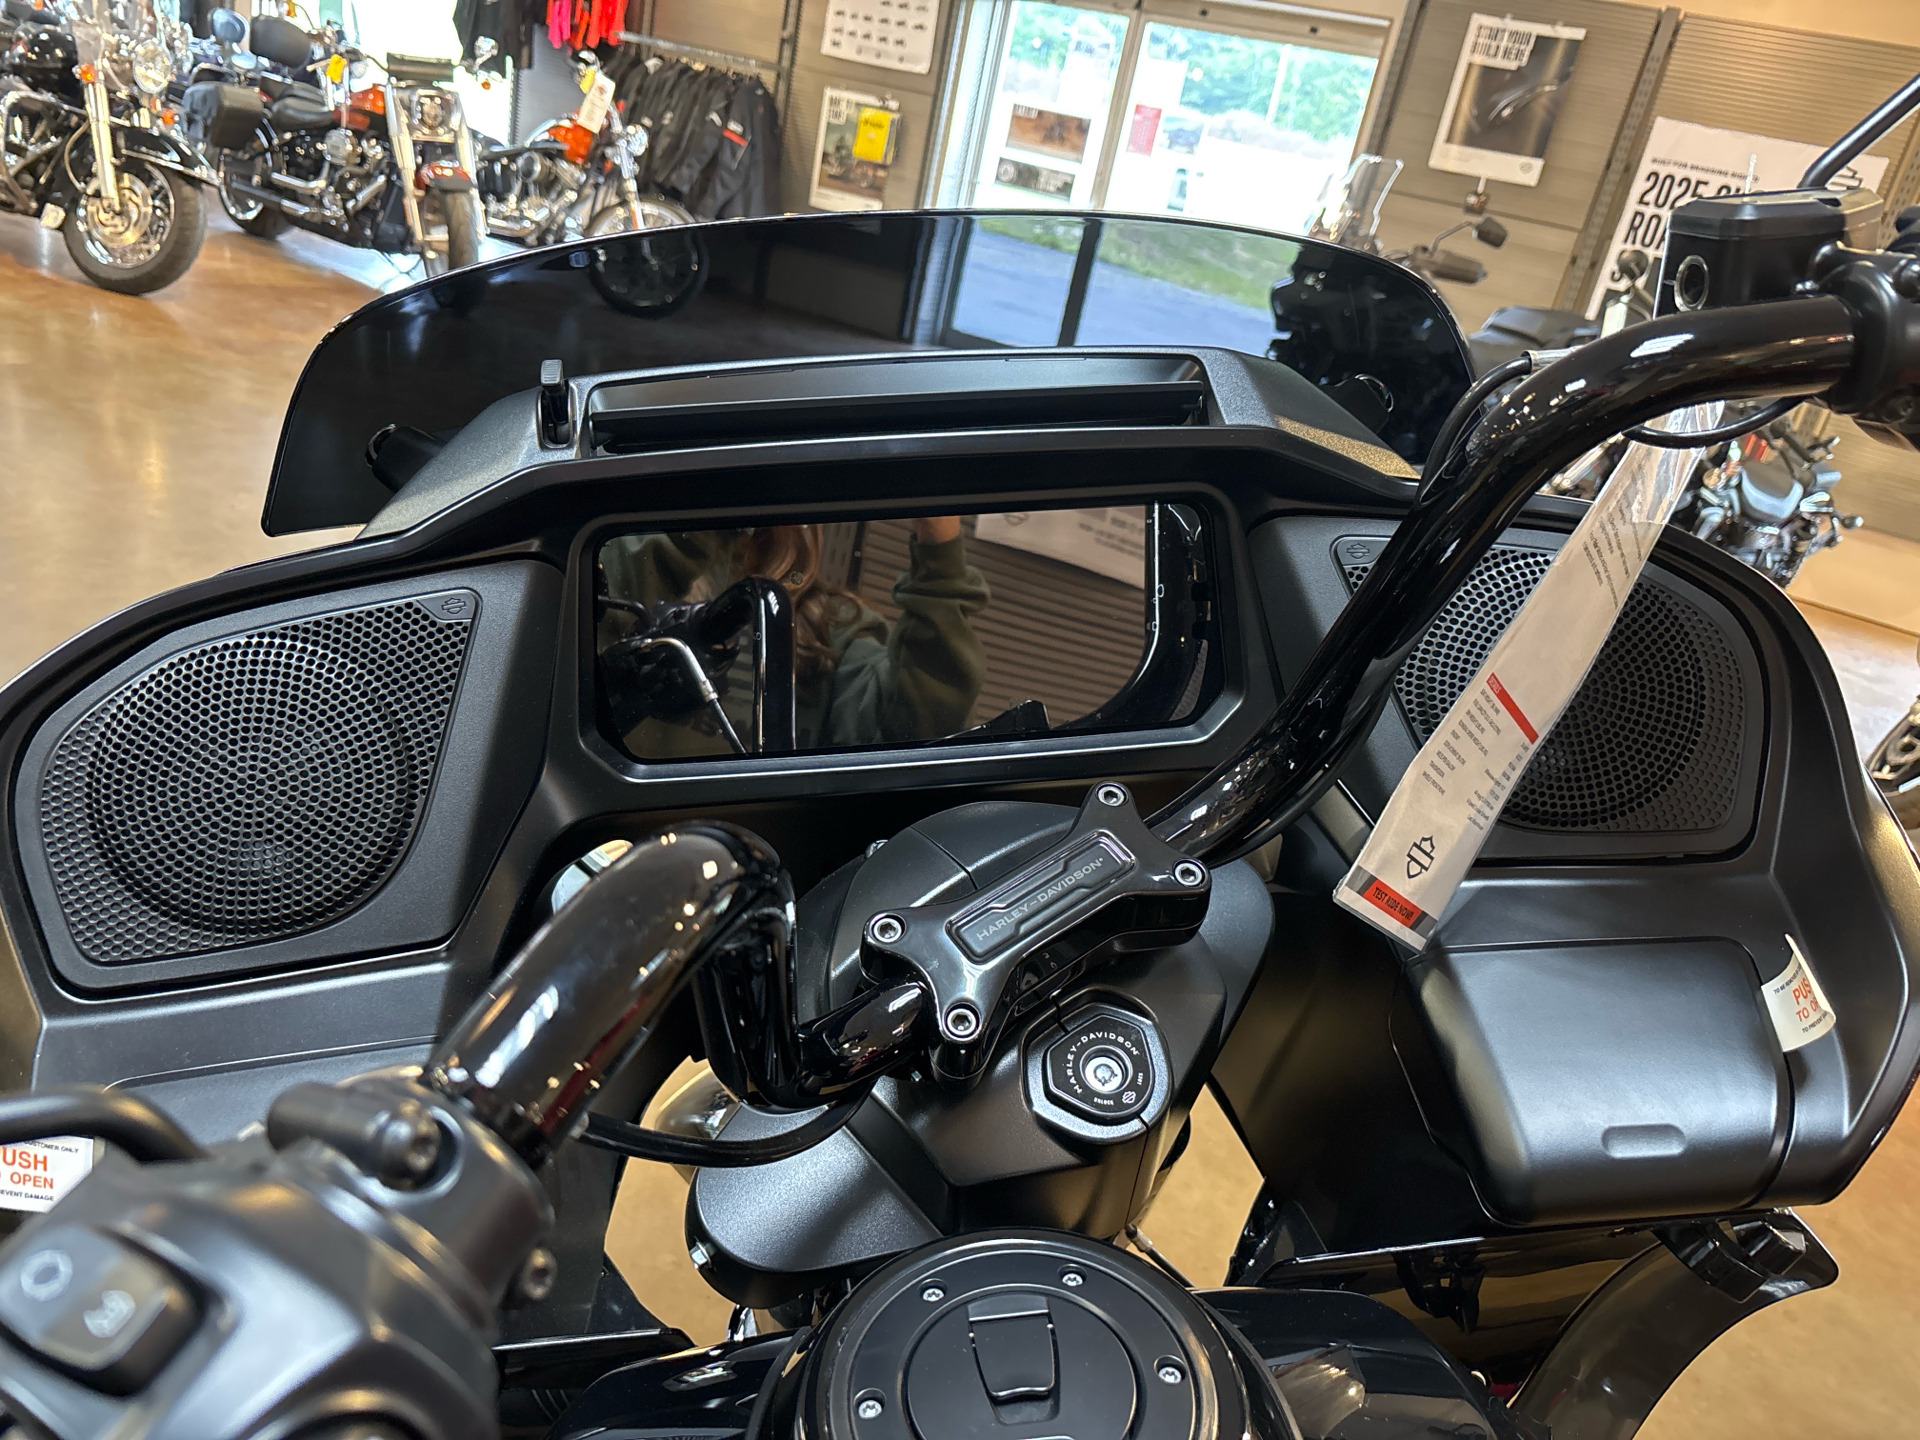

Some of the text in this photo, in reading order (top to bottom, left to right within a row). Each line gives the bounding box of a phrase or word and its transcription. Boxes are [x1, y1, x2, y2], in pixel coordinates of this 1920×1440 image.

[1639, 171, 1709, 210] 2025
[1372, 886, 1388, 902] TEST
[1385, 896, 1400, 911] RIDE
[1792, 977, 1812, 1006] PUS
[1795, 1007, 1809, 1022] TO
[0, 1147, 47, 1171] USH
[10, 1171, 54, 1189] OPEN
[24, 1193, 54, 1201] DAMAGE
